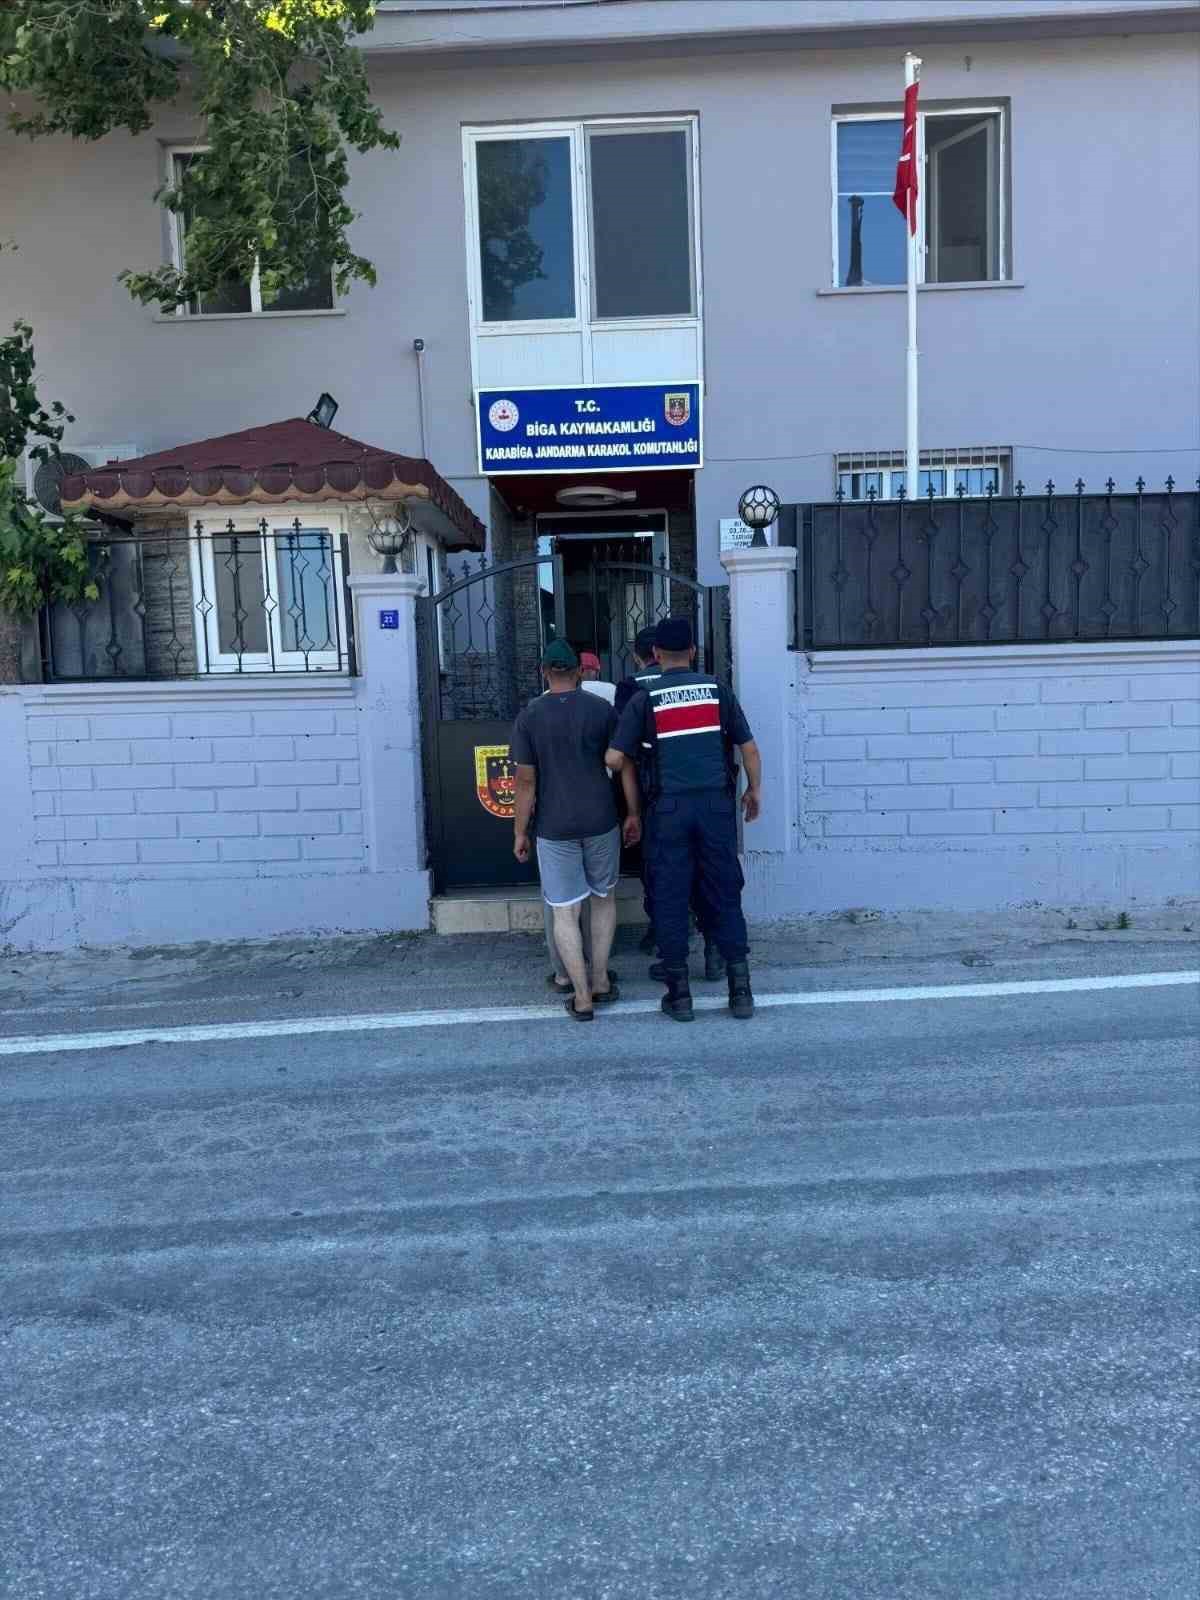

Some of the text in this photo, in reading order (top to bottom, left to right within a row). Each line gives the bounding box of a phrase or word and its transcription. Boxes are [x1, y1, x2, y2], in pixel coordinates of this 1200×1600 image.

[575, 400, 601, 412] T.C.
[526, 418, 656, 436] BİGA KAYMAKAMLIĞI
[486, 438, 698, 460] KARABİGA JANDARMA KARAKOL KOMUTANLIĞI
[659, 687, 713, 706] JANDARMA
